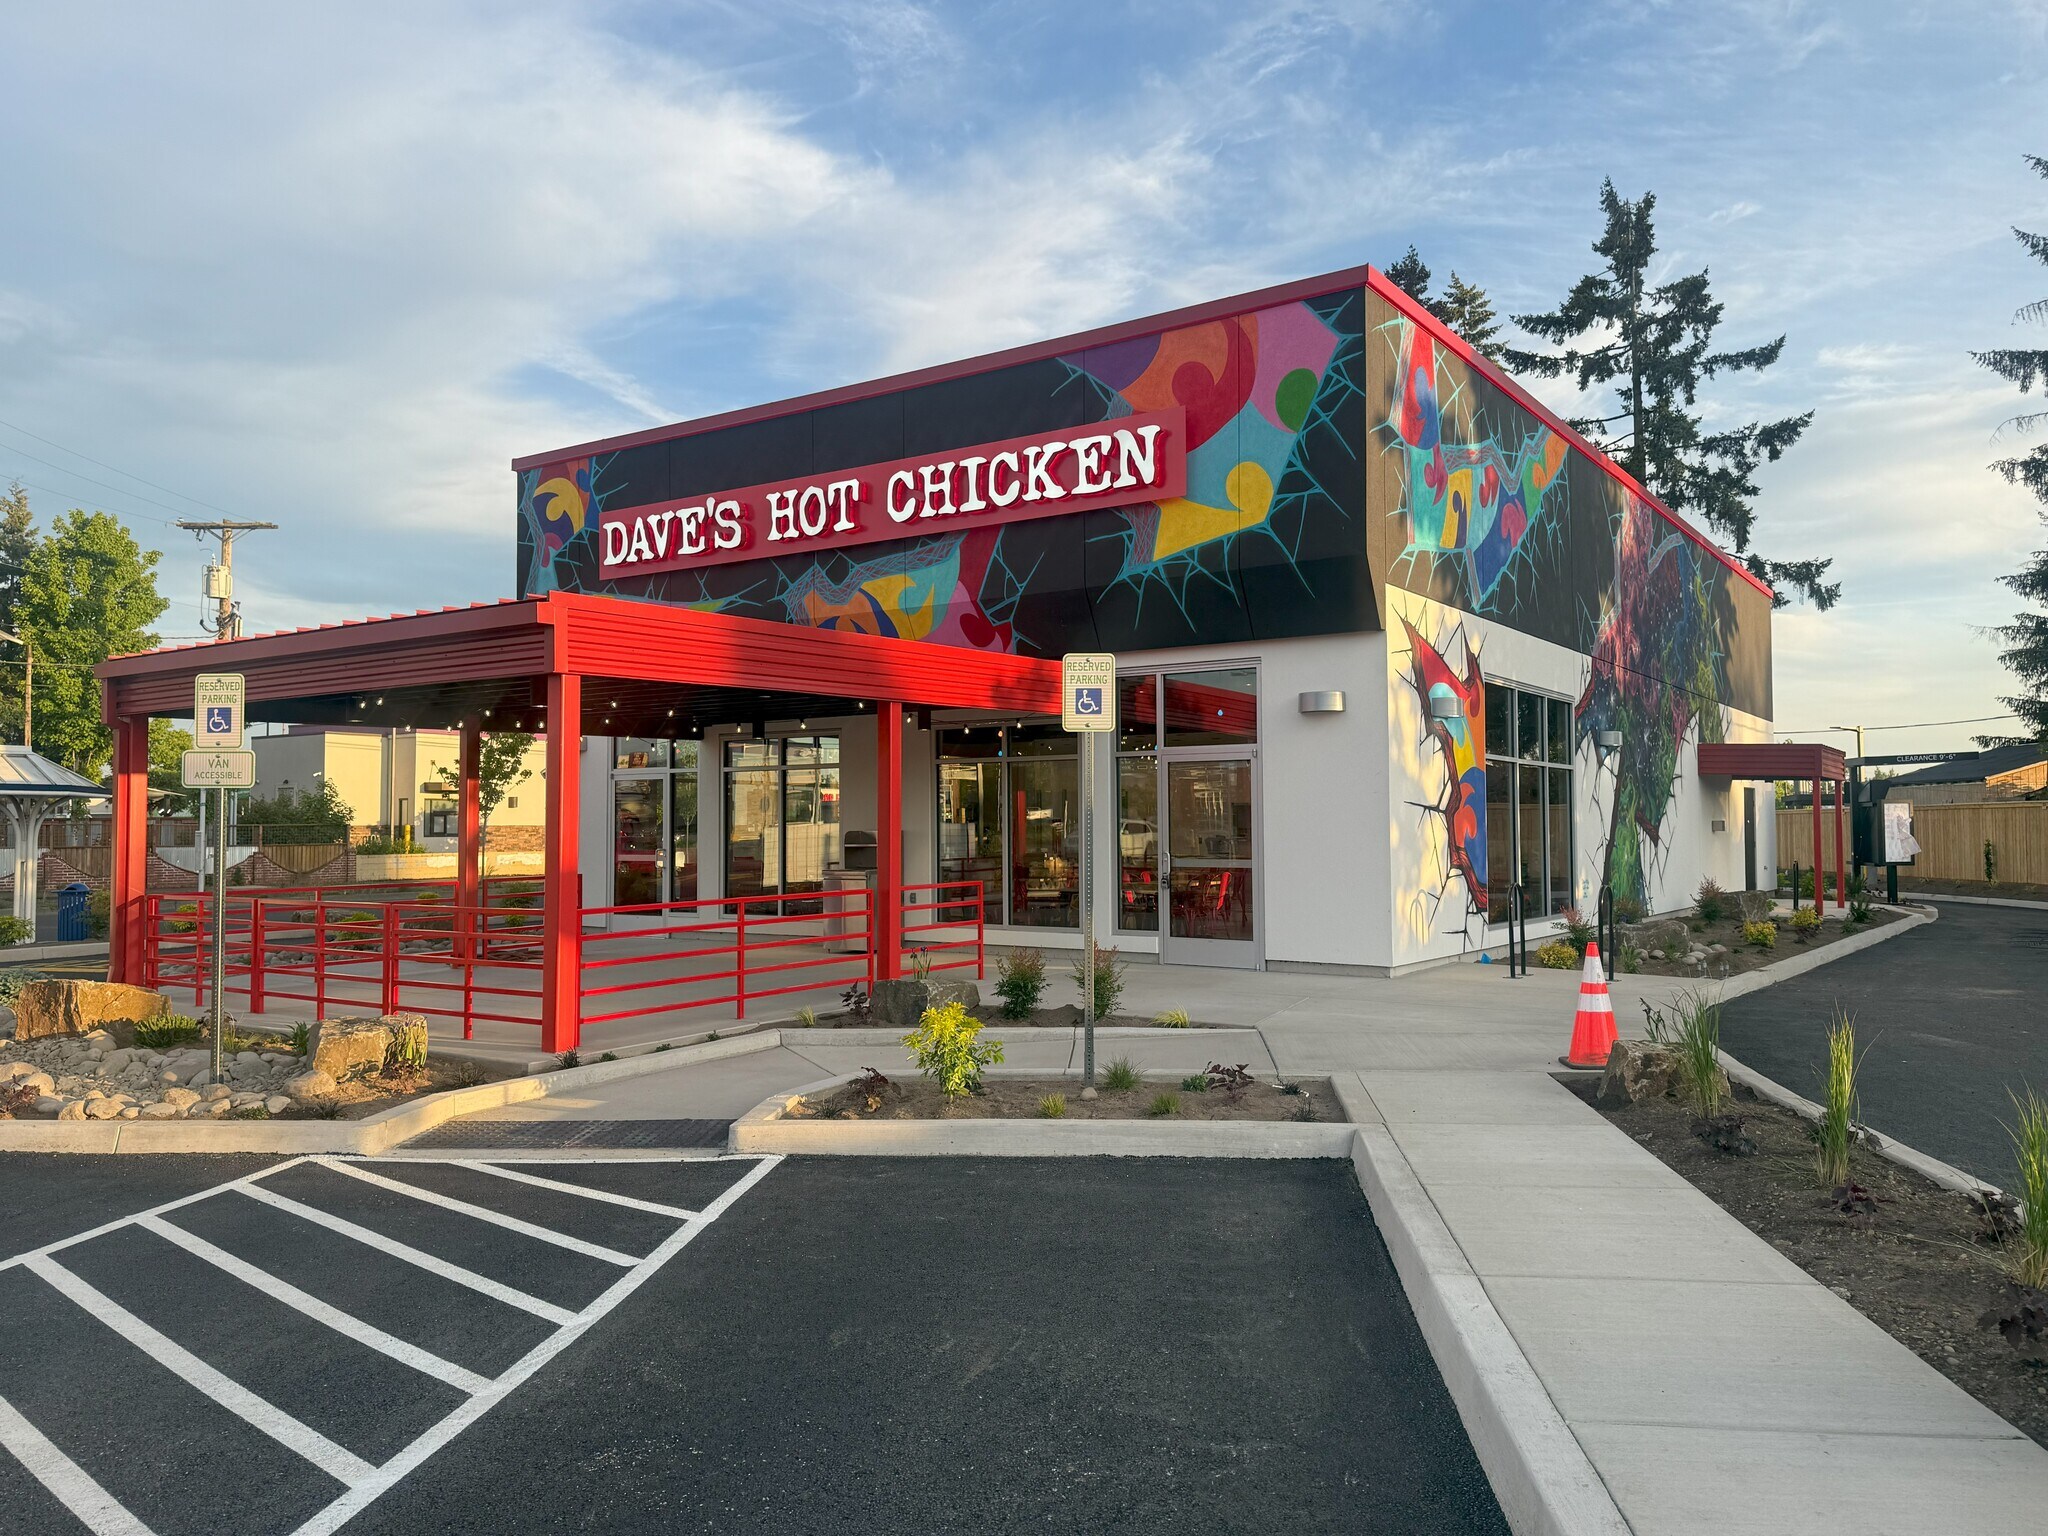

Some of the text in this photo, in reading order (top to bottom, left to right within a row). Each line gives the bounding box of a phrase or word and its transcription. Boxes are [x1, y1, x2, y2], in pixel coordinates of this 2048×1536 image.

[602, 424, 1161, 566] DAVE'S HOT CHICKEN
[1066, 661, 1111, 672] RESERVED
[1069, 674, 1108, 685] PARKING
[199, 681, 240, 691] RESERVED
[201, 694, 237, 704] PARKING
[1896, 754, 1937, 762] CLEARANCE
[208, 759, 229, 769] VAN
[194, 771, 242, 779] ACCESSIBLE
